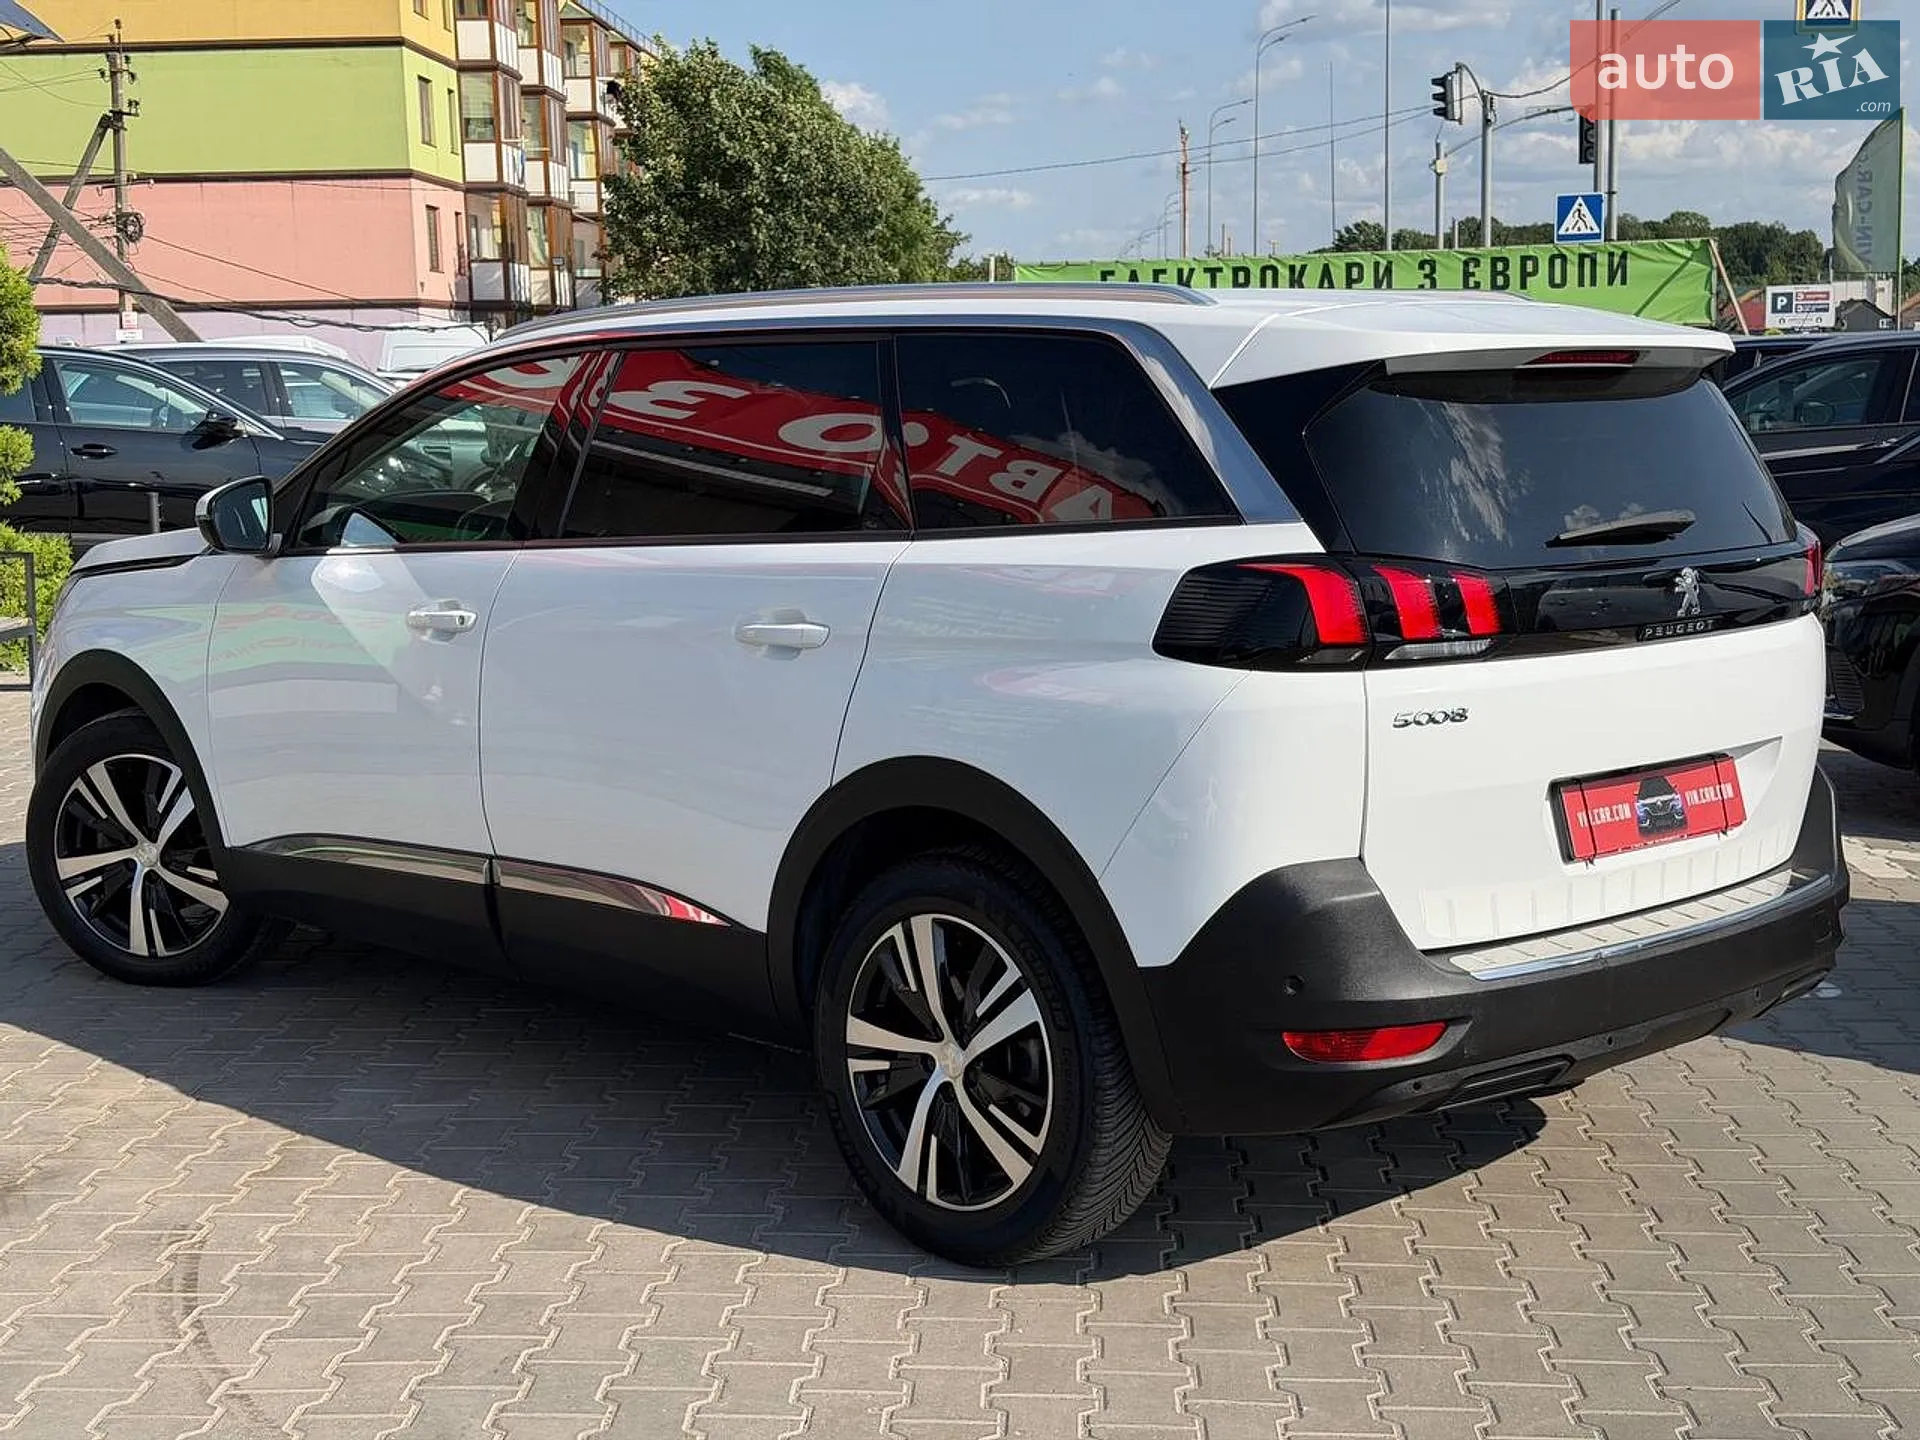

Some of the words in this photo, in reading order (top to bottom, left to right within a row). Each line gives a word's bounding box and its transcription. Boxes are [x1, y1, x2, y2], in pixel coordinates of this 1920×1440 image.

[1462, 251, 1628, 290] ЄВРОПИ
[1645, 619, 1714, 638] PEUGEOT
[1392, 707, 1469, 728] 5008
